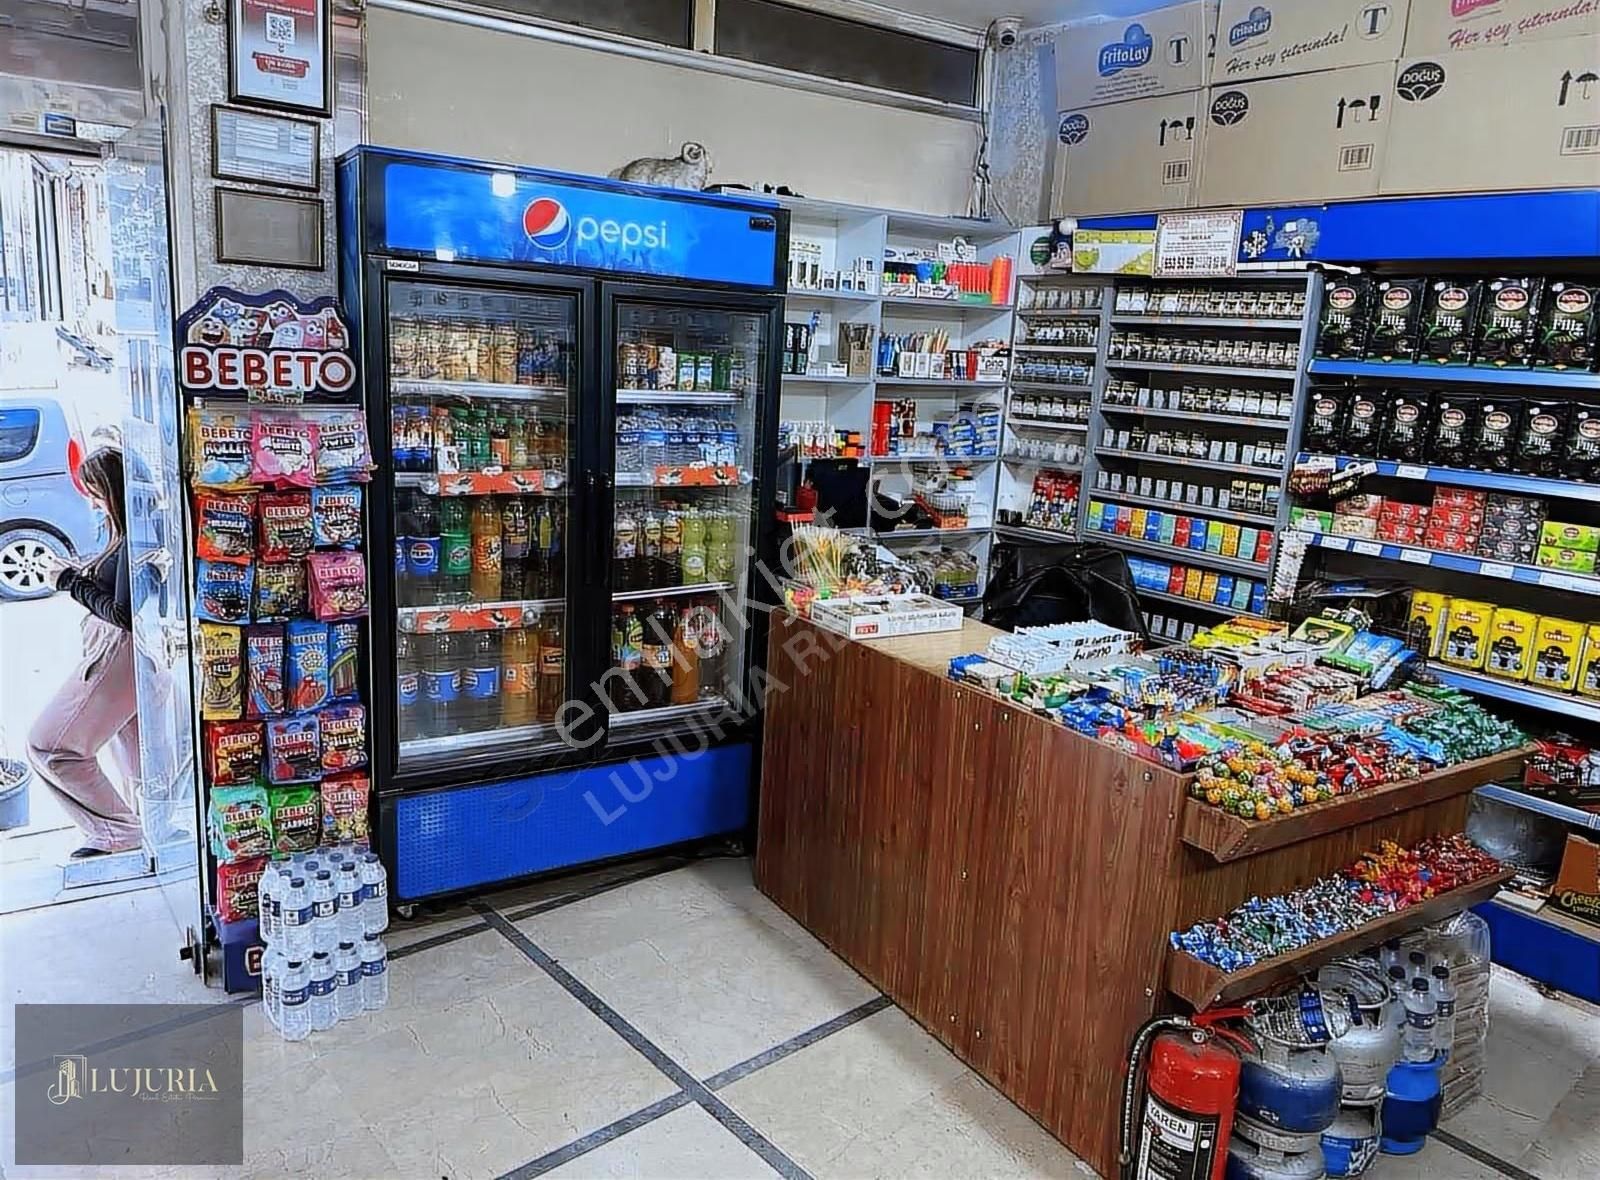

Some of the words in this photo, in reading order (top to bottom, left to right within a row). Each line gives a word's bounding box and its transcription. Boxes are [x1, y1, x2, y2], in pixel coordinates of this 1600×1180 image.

[576, 216, 668, 252] pepsi
[185, 350, 353, 389] BEBETO
[1150, 1102, 1188, 1135] YAREN
